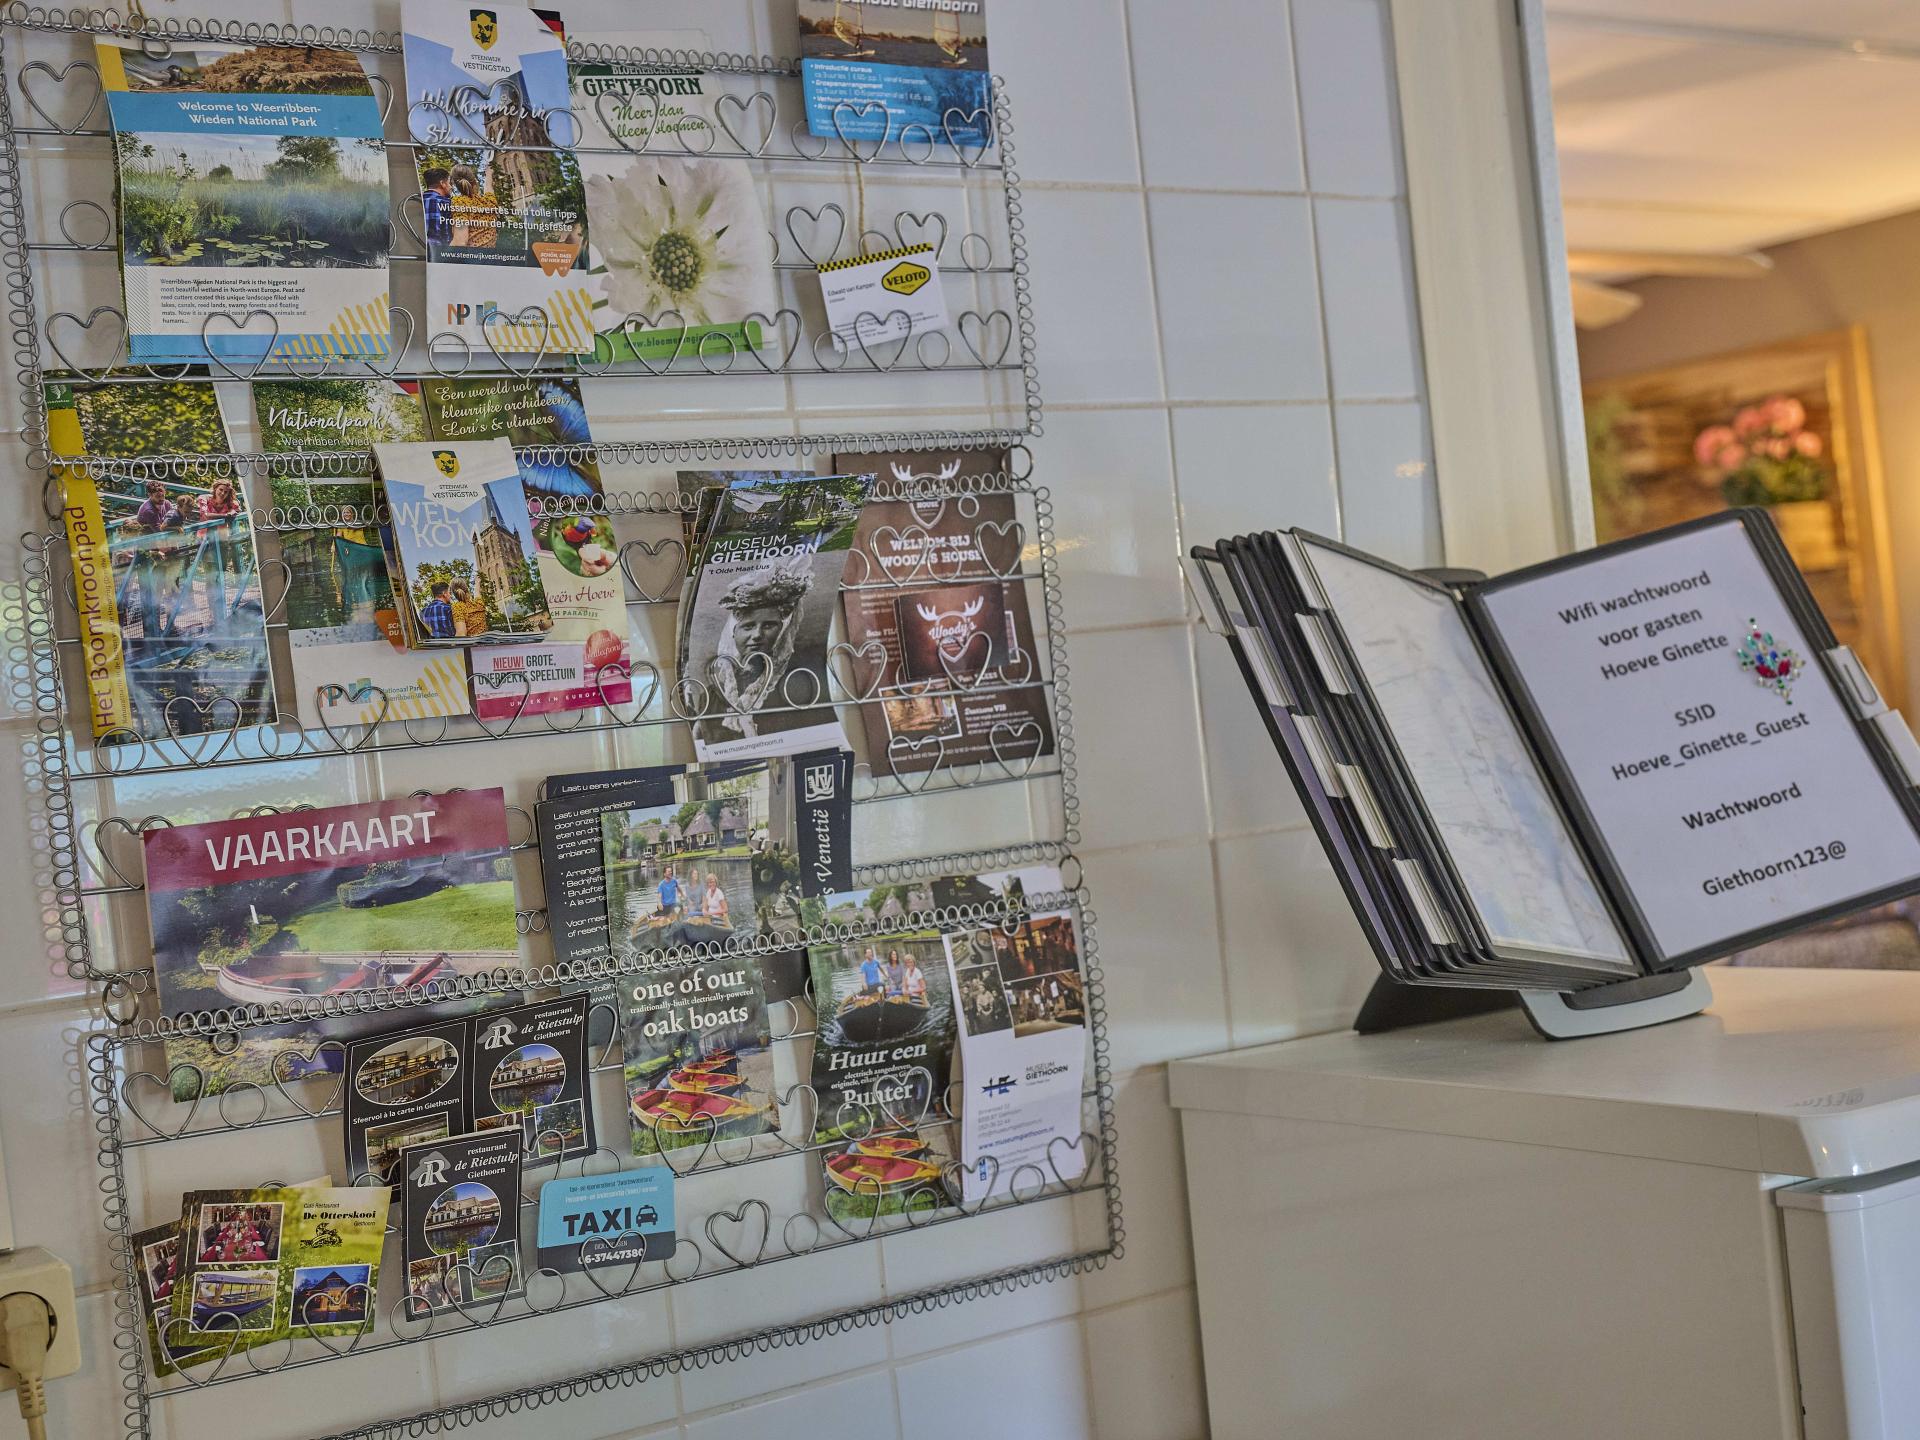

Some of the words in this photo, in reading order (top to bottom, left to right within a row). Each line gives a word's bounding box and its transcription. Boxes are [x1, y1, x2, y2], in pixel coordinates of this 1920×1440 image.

[463, 61, 510, 73] VESTINGSTAD
[178, 102, 234, 111] Welcome
[236, 104, 248, 112] to
[251, 103, 321, 113] Weerribben-
[612, 105, 654, 121] Meer
[658, 104, 684, 116] dan
[189, 114, 235, 124] Wieden
[238, 116, 288, 126] National
[292, 117, 317, 127] Park
[437, 203, 510, 216] Wissenswertes
[511, 207, 529, 216] und
[530, 208, 551, 218] tolle
[553, 209, 577, 220] Tipps
[439, 216, 488, 228] Programm
[490, 219, 506, 228] der
[507, 221, 572, 232] Festungsfeste
[886, 270, 926, 287] VELOTO
[435, 387, 466, 400] Een
[469, 380, 511, 397] wereld
[512, 378, 534, 392] vol
[441, 400, 502, 419] kleurrijke
[269, 406, 384, 437] Nationalpark
[441, 419, 488, 436] Lori's
[491, 418, 503, 431] &
[507, 413, 555, 429] vlinders
[432, 491, 478, 499] VESTINGSTAD
[713, 534, 788, 553] MUSEUM
[949, 535, 970, 547] BIJ
[711, 543, 820, 564] GIETHOORN
[64, 505, 109, 681] Boomkroonpad
[576, 586, 615, 602] Hoeve
[1557, 596, 1599, 625] Wifi
[1599, 570, 1712, 615] wachtwoord
[928, 617, 977, 640] Woody's
[1597, 625, 1640, 648] voor
[1644, 606, 1703, 638] gasten
[493, 656, 525, 668] NIEUW!
[526, 654, 556, 667] GROTE,
[1599, 653, 1660, 681] Hoeve
[1661, 633, 1730, 662] Ginette
[530, 668, 576, 682] SPEELTUIN
[94, 687, 116, 729] Het
[1674, 703, 1717, 727] SSID
[1610, 710, 1810, 781] Hoeve_Ginette_Guest
[562, 785, 581, 793] Laat
[553, 812, 573, 820] Laat
[600, 800, 635, 811] verleiden
[1681, 782, 1803, 831] Wachtwoord
[555, 822, 574, 830] door
[575, 818, 594, 826] onze
[205, 810, 437, 872] VAARKAART
[555, 831, 574, 839] eten
[557, 841, 576, 849] onze
[557, 847, 597, 859] ambiance.
[812, 809, 833, 883] Venetië
[1701, 839, 1848, 897] Giethoorn123@
[570, 944, 605, 957] Hollands
[633, 980, 675, 1001] one
[680, 967, 705, 993] of
[707, 970, 746, 989] our
[630, 999, 690, 1014] traditionally-built
[691, 987, 754, 1004] electrically-powered
[534, 1007, 573, 1019] restaurant
[643, 1009, 686, 1037] oak
[688, 1006, 749, 1030] boats
[521, 1024, 534, 1034] de
[537, 1014, 583, 1031] Rietstulp
[533, 1029, 571, 1041] Giethoorn
[828, 1049, 889, 1071] Huur
[892, 1044, 928, 1060] een
[844, 1068, 873, 1080] electrisch
[1026, 1065, 1068, 1080] GIETHOORN
[842, 1084, 914, 1110] Punter
[353, 1115, 382, 1124] Sfeervol
[397, 1107, 415, 1115] carte
[424, 1097, 460, 1109] Giethoorn
[467, 1143, 507, 1155] restaurant
[454, 1160, 467, 1171] de
[470, 1151, 518, 1168] Rietstulp
[467, 1167, 506, 1179] Giethoorn
[320, 1211, 376, 1219] Otterskooi
[563, 1207, 631, 1237] TAXI
